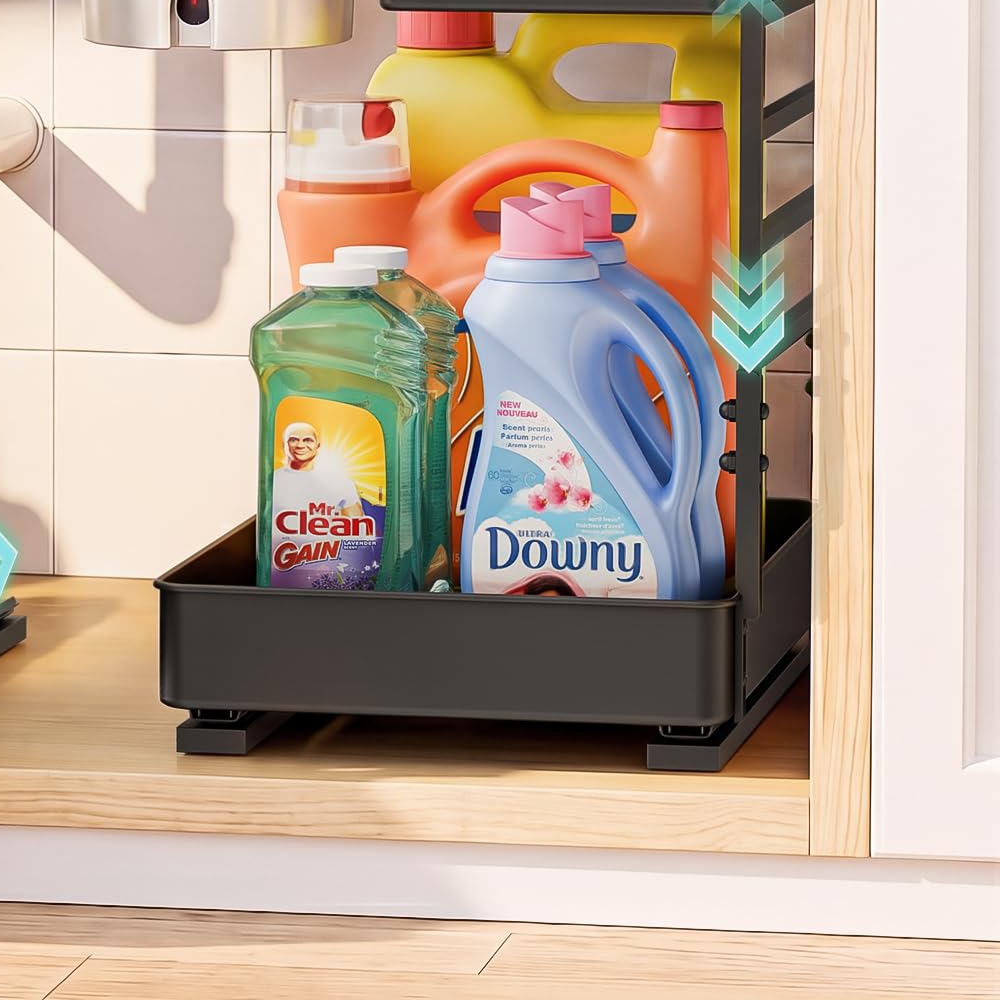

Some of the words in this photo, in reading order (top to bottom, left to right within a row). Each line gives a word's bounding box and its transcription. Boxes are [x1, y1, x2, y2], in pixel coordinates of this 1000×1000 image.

[496, 409, 538, 418] NOUVEAU
[502, 424, 526, 432] Scent
[501, 433, 529, 441] Parfum
[308, 502, 339, 516] Mr.
[276, 510, 374, 536] Clean
[518, 530, 551, 538] ULTRA
[274, 541, 340, 570] GAIN
[485, 526, 642, 583] Downy
